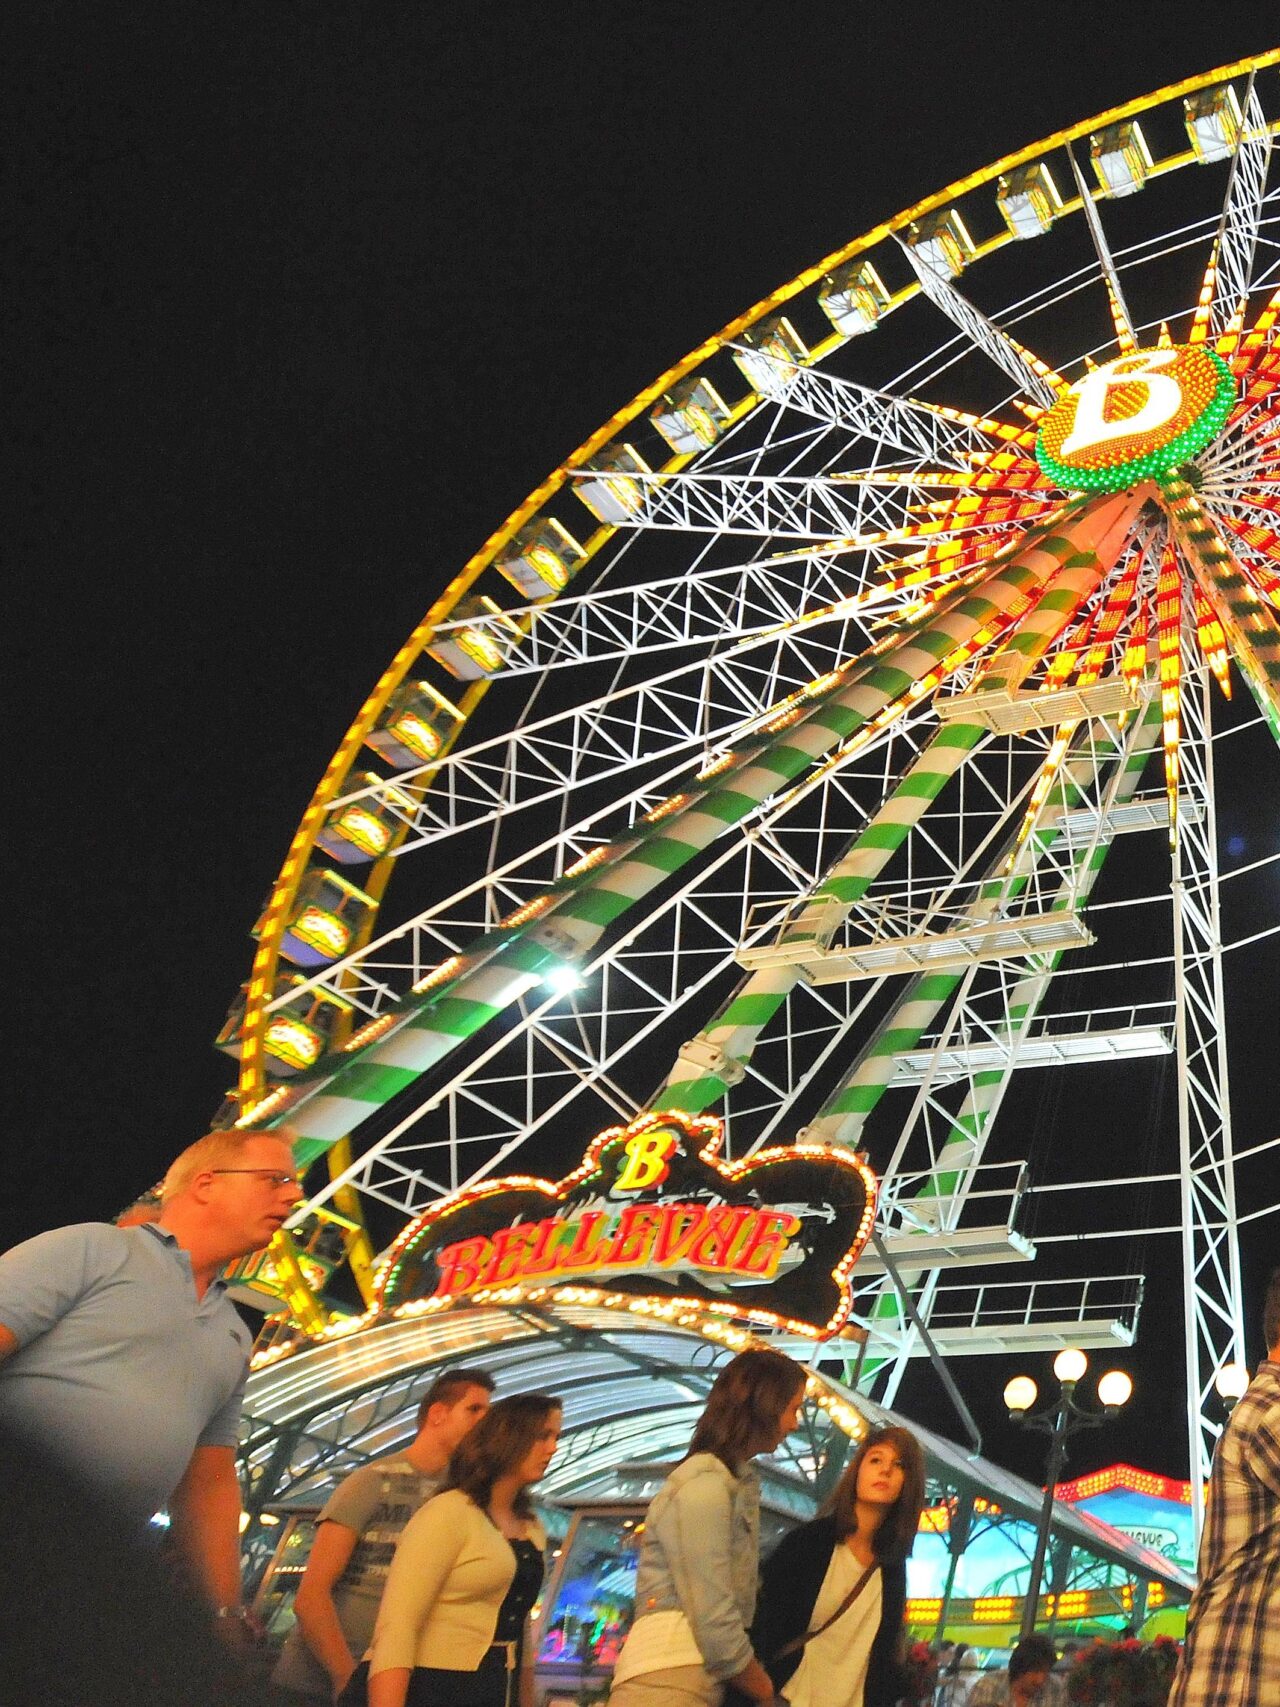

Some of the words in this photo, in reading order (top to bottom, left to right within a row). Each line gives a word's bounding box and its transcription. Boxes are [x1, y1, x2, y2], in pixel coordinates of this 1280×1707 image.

[1060, 349, 1182, 456] B
[615, 1131, 676, 1191] B
[435, 1202, 802, 1295] BELLEVUE
